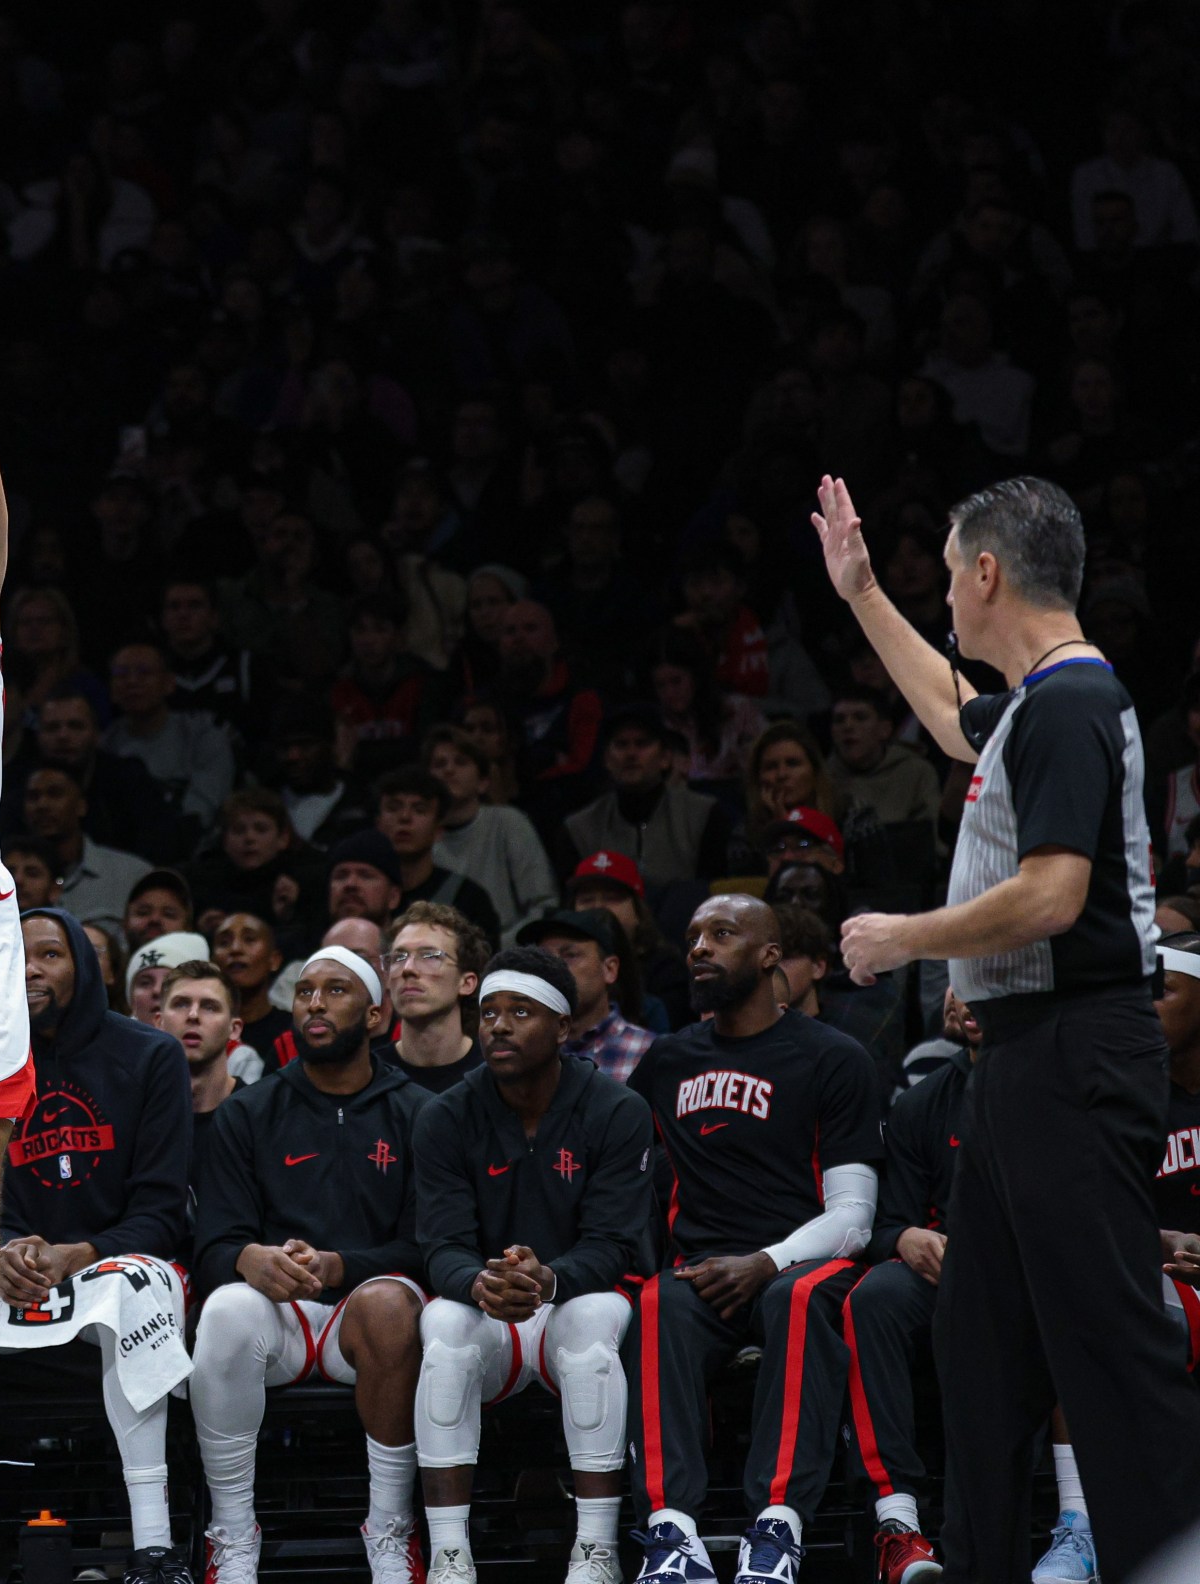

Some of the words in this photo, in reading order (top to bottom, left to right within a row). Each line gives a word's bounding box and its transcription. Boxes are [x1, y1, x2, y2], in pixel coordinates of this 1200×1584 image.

[675, 1069, 775, 1120] ROCKETS
[22, 1129, 101, 1159] ROCKETS
[120, 1312, 175, 1352] CHANGE
[150, 1333, 170, 1351] WITH
